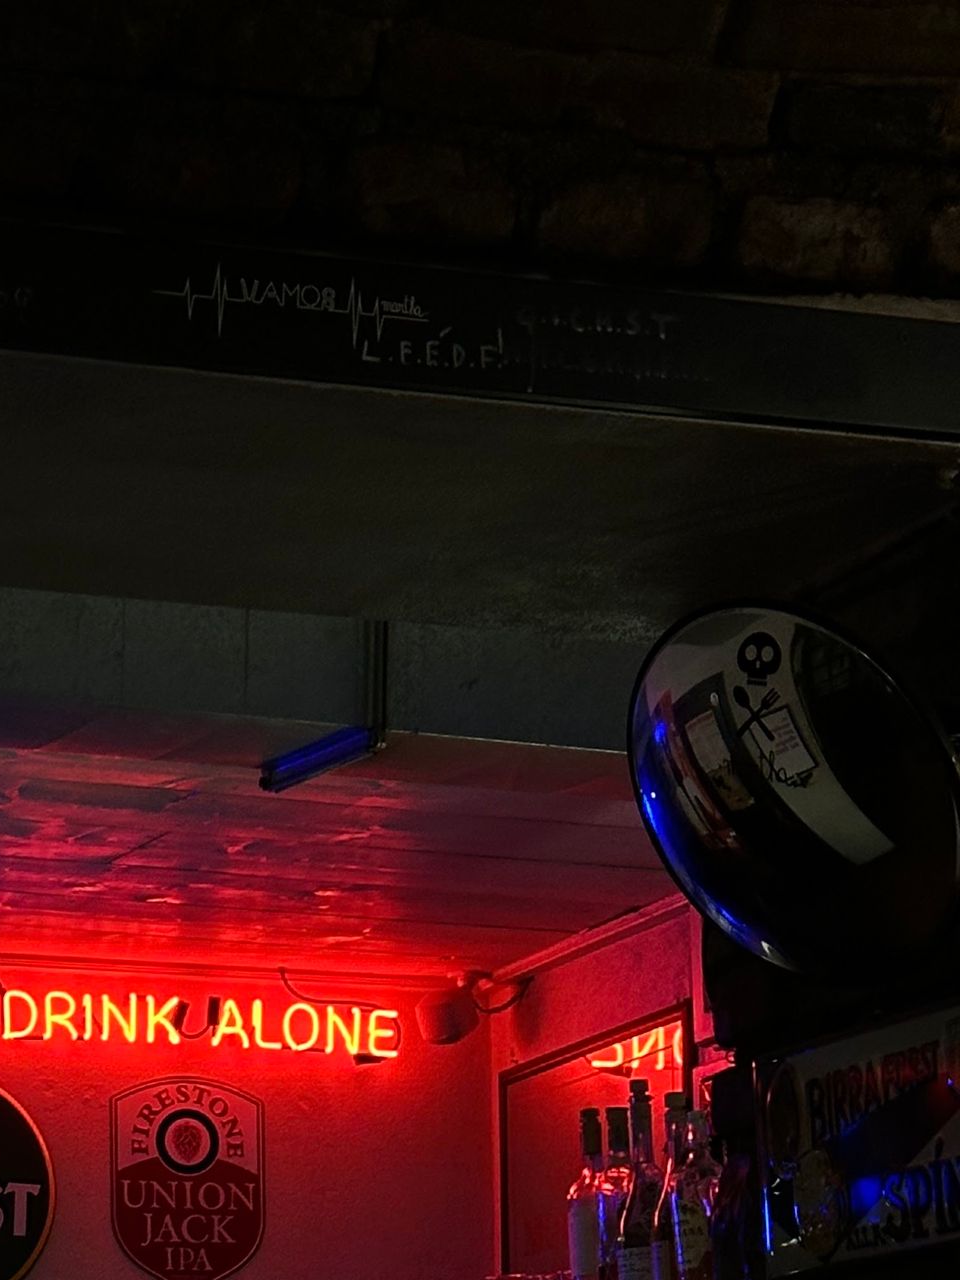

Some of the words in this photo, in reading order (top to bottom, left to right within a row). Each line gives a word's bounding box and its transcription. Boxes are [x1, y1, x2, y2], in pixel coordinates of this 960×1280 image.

[2, 990, 181, 1045] DRINK
[210, 998, 399, 1059] ALONE
[131, 1084, 245, 1158] FIRESTONE
[120, 1179, 257, 1212] UNION
[139, 1213, 238, 1247] JACK
[164, 1247, 214, 1272] IPA
